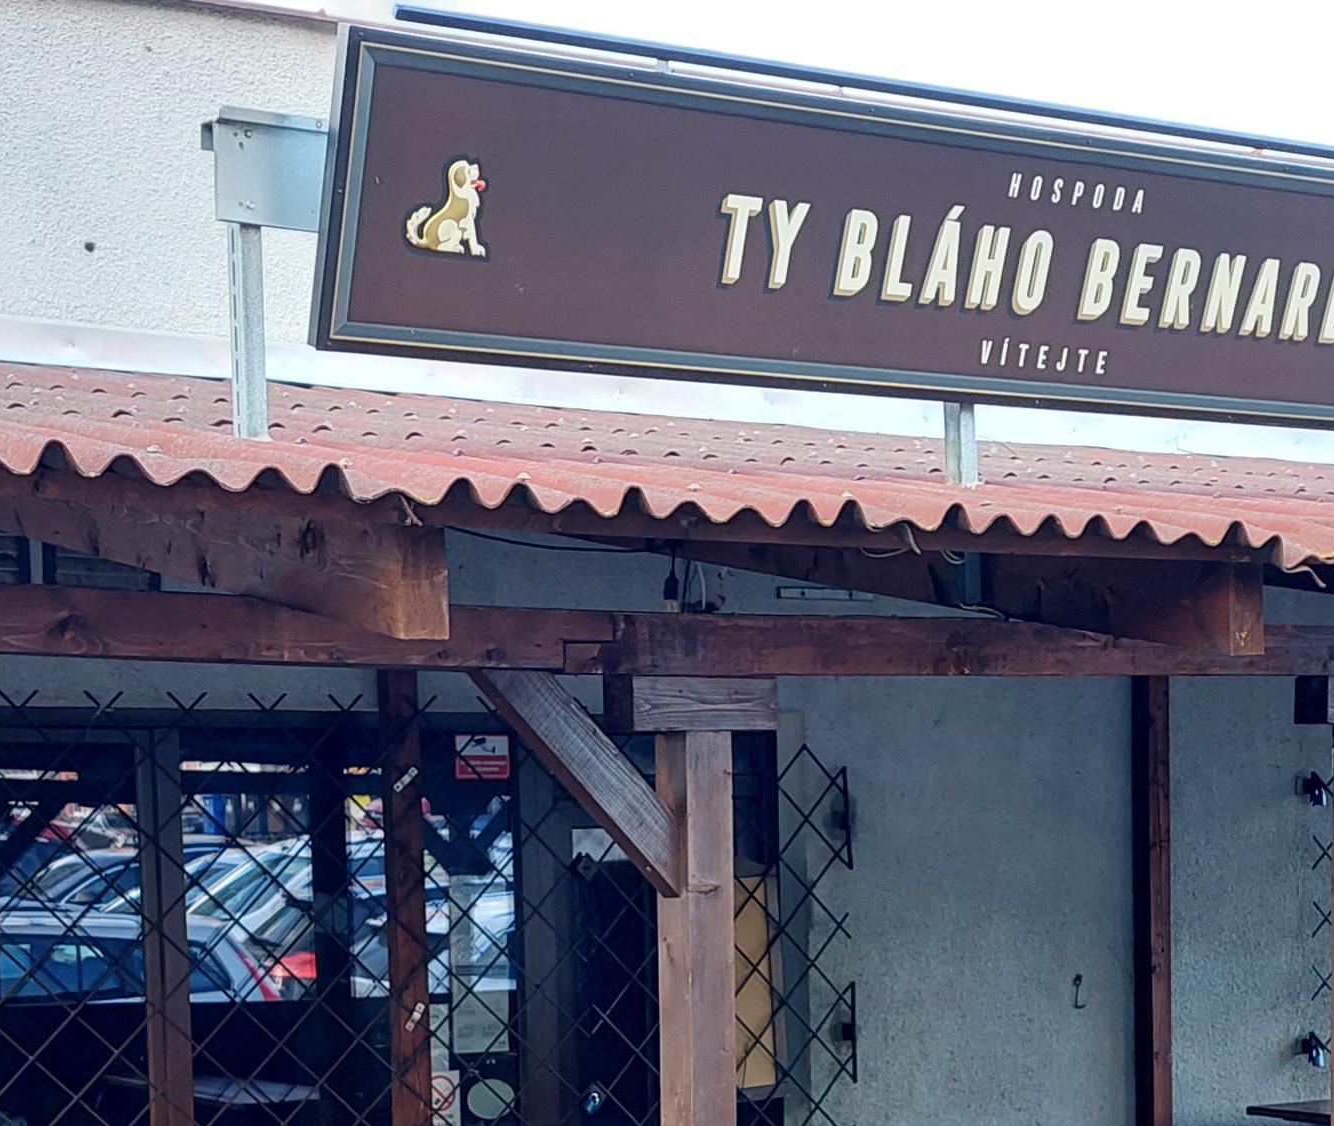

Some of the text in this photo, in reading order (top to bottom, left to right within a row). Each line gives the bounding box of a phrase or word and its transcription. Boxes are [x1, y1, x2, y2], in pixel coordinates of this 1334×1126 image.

[1008, 172, 1145, 214] HOSPODA
[721, 193, 811, 289] TY
[833, 204, 1055, 315] BLÁHO
[980, 337, 1108, 375] VÍTEJTE
